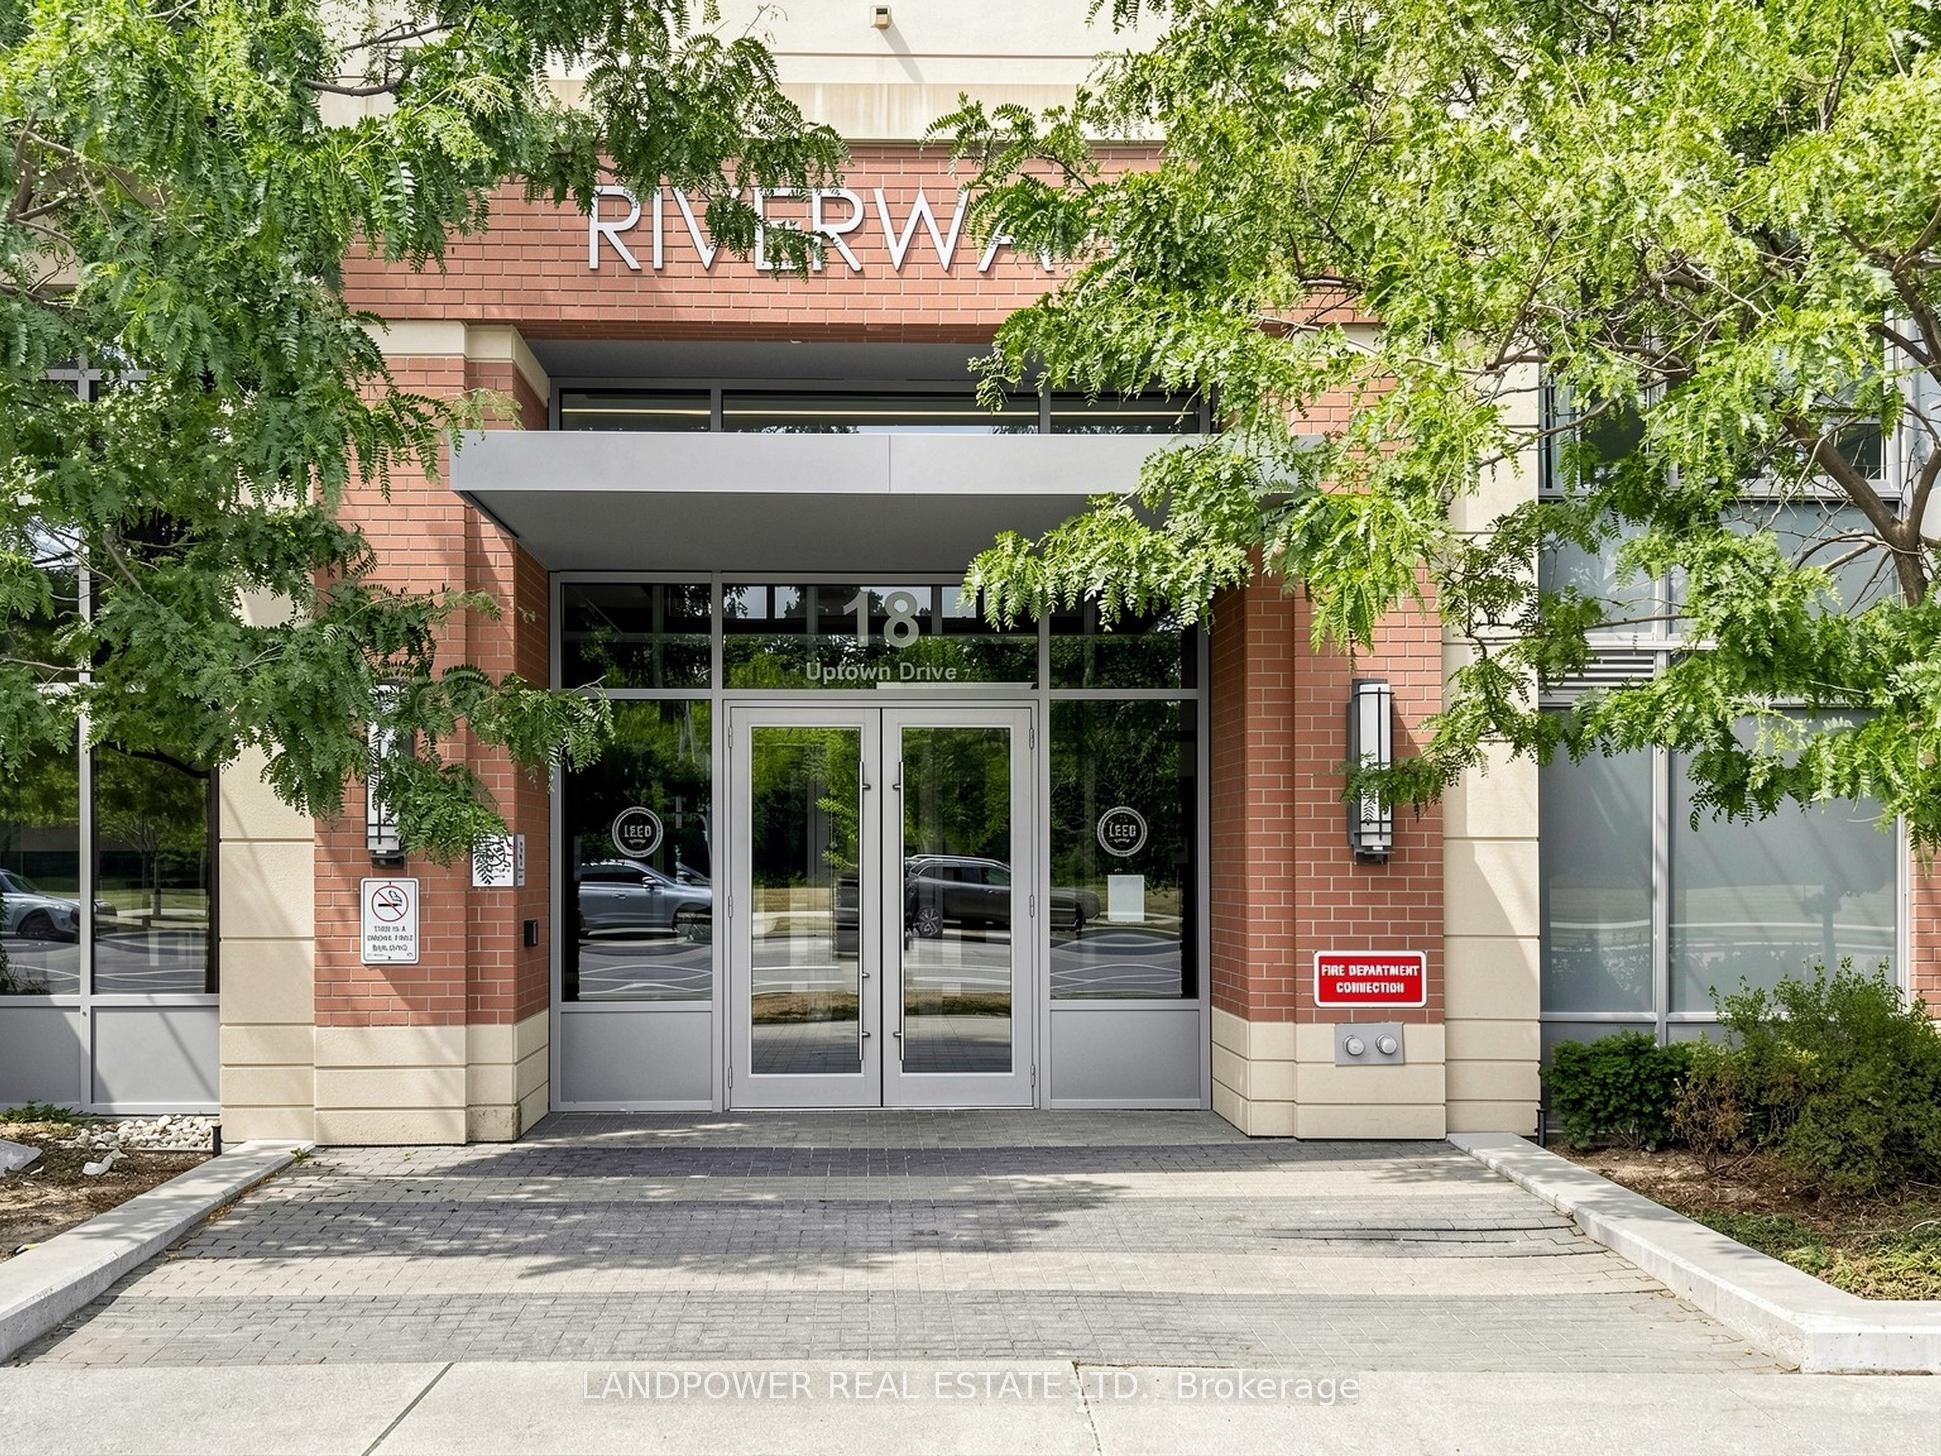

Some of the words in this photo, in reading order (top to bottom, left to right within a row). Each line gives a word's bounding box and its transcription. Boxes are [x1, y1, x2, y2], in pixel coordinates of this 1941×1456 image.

[843, 590, 920, 648] 18
[806, 661, 891, 685] Uptown
[899, 662, 957, 681] Drive
[1321, 964, 1345, 977] FIRE
[1348, 964, 1420, 977] DEPARTMENT
